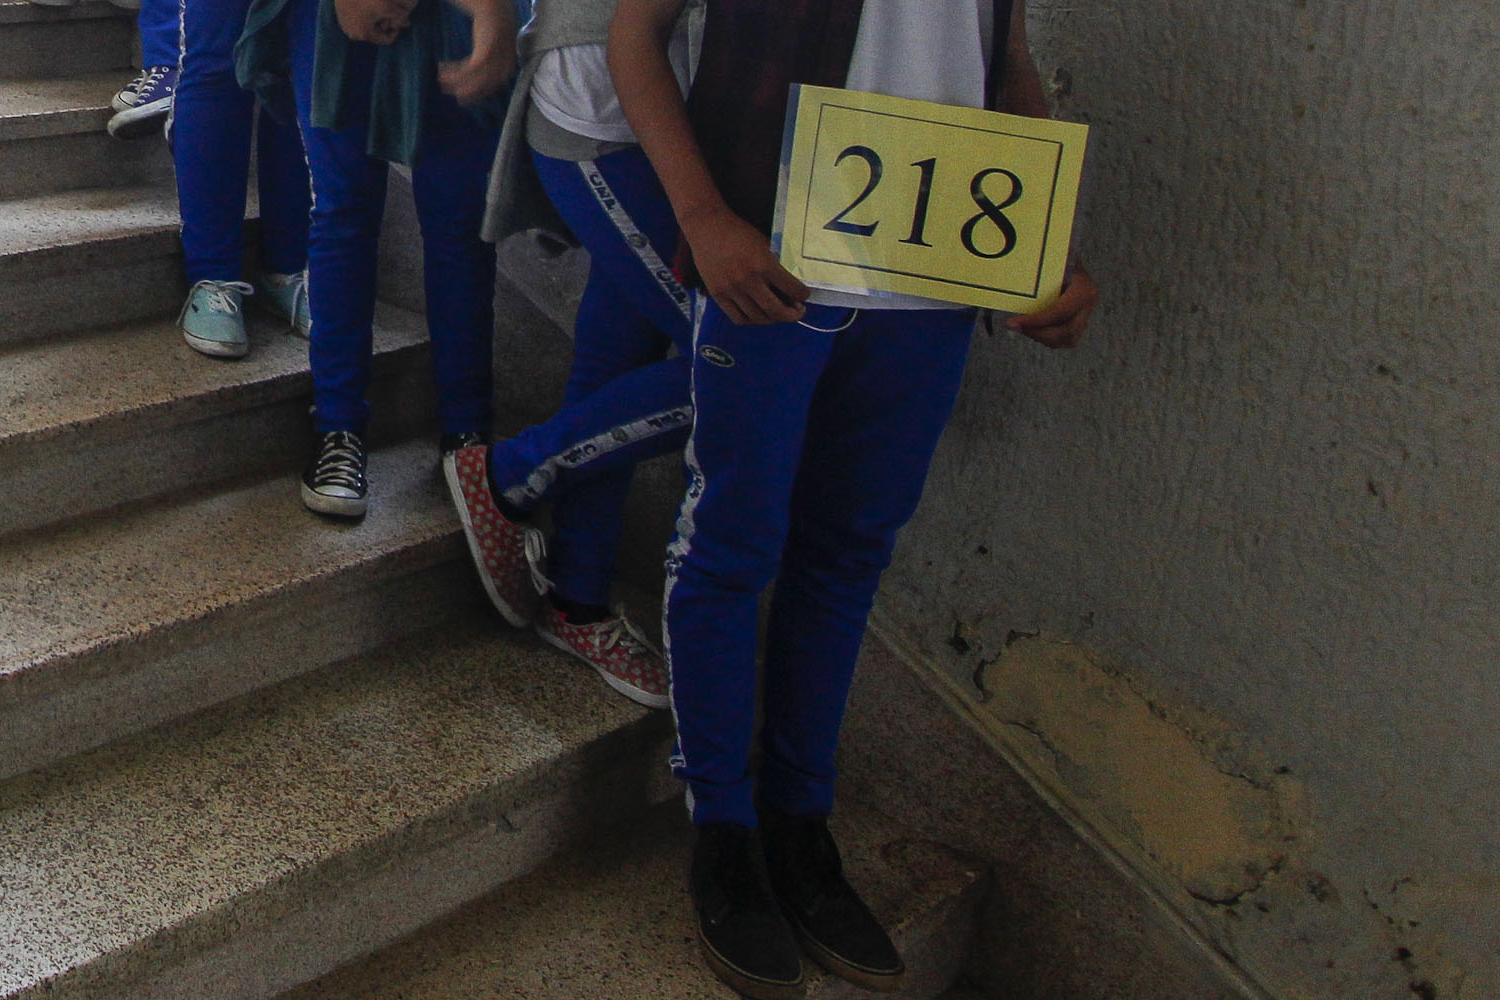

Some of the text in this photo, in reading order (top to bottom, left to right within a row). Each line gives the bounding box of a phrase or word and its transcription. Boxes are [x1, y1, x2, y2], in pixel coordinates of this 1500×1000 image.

[589, 172, 617, 211] CEP
[822, 144, 1024, 260] 218
[656, 269, 688, 305] CEP
